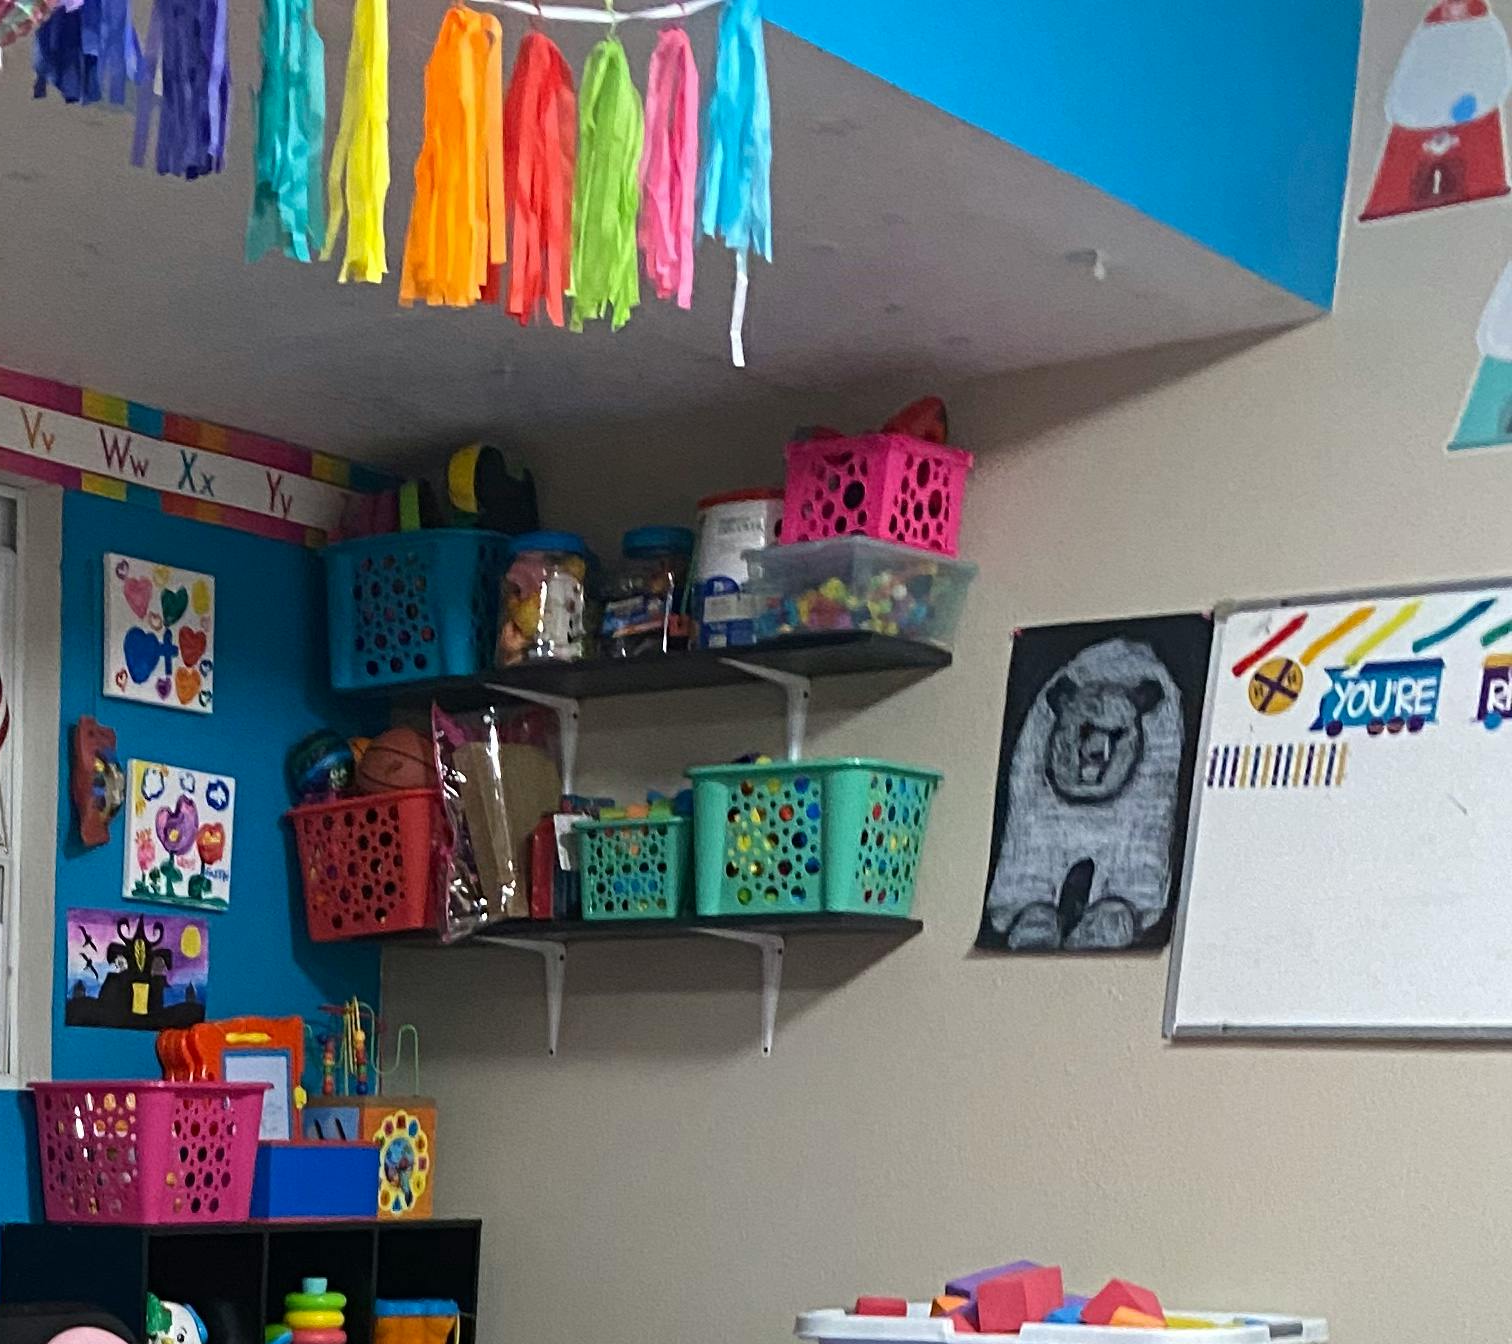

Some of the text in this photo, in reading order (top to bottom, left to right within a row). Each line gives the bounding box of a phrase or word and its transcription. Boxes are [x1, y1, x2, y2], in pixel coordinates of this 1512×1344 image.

[19, 406, 56, 453] Vv
[99, 427, 150, 479] Ww
[176, 449, 216, 499] Xx
[265, 470, 293, 520] Yy
[1333, 675, 1439, 721] YOU'RE
